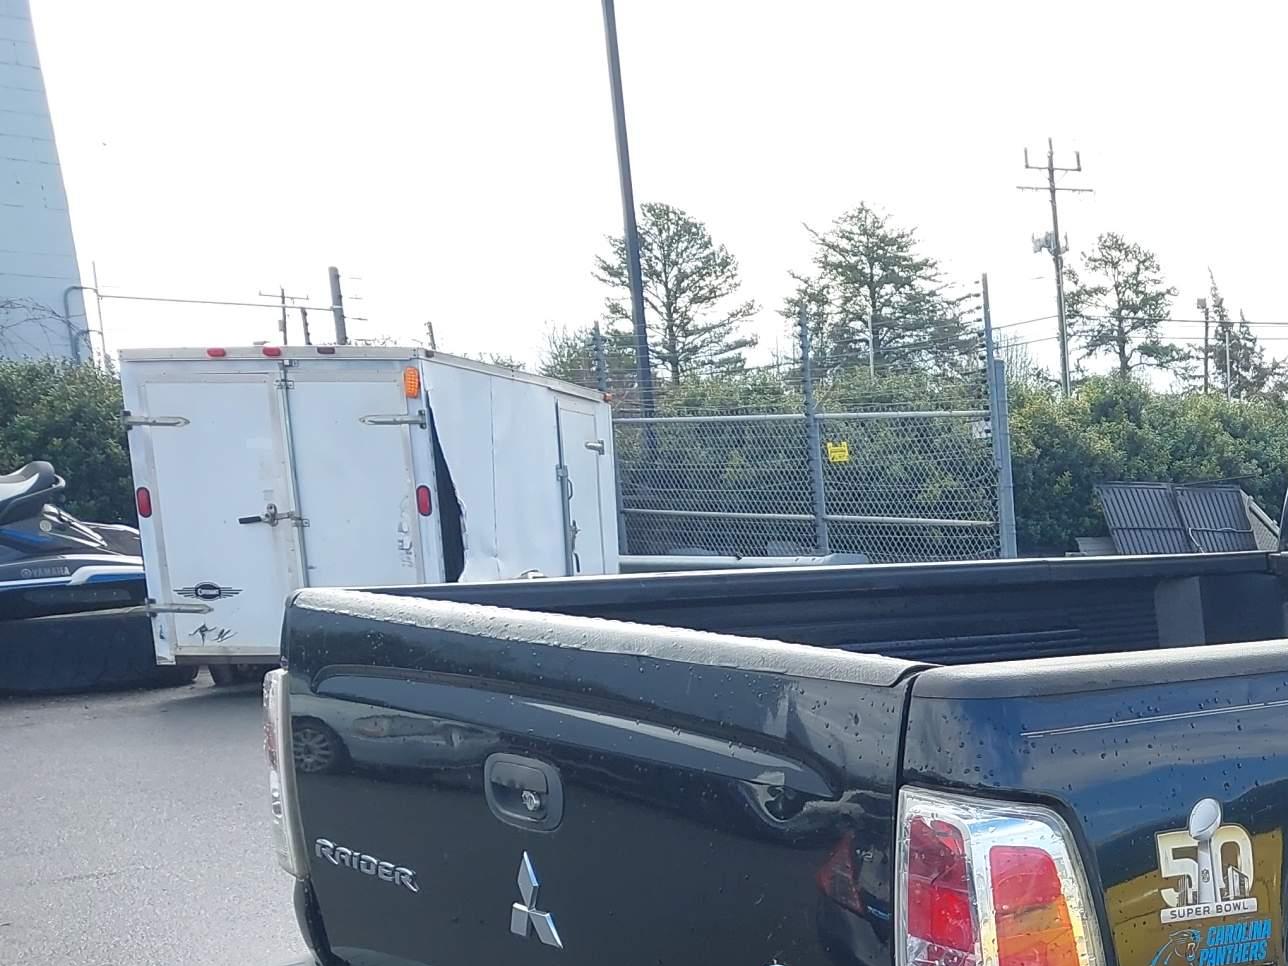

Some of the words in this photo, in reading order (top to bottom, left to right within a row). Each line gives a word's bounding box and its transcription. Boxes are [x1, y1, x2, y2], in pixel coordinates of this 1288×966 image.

[32, 566, 71, 577] YAMAHA
[315, 838, 420, 893] RAIDER
[1170, 905, 1210, 920] SUPER
[1216, 901, 1249, 914] BOWL
[1207, 918, 1273, 946] CAROLINA
